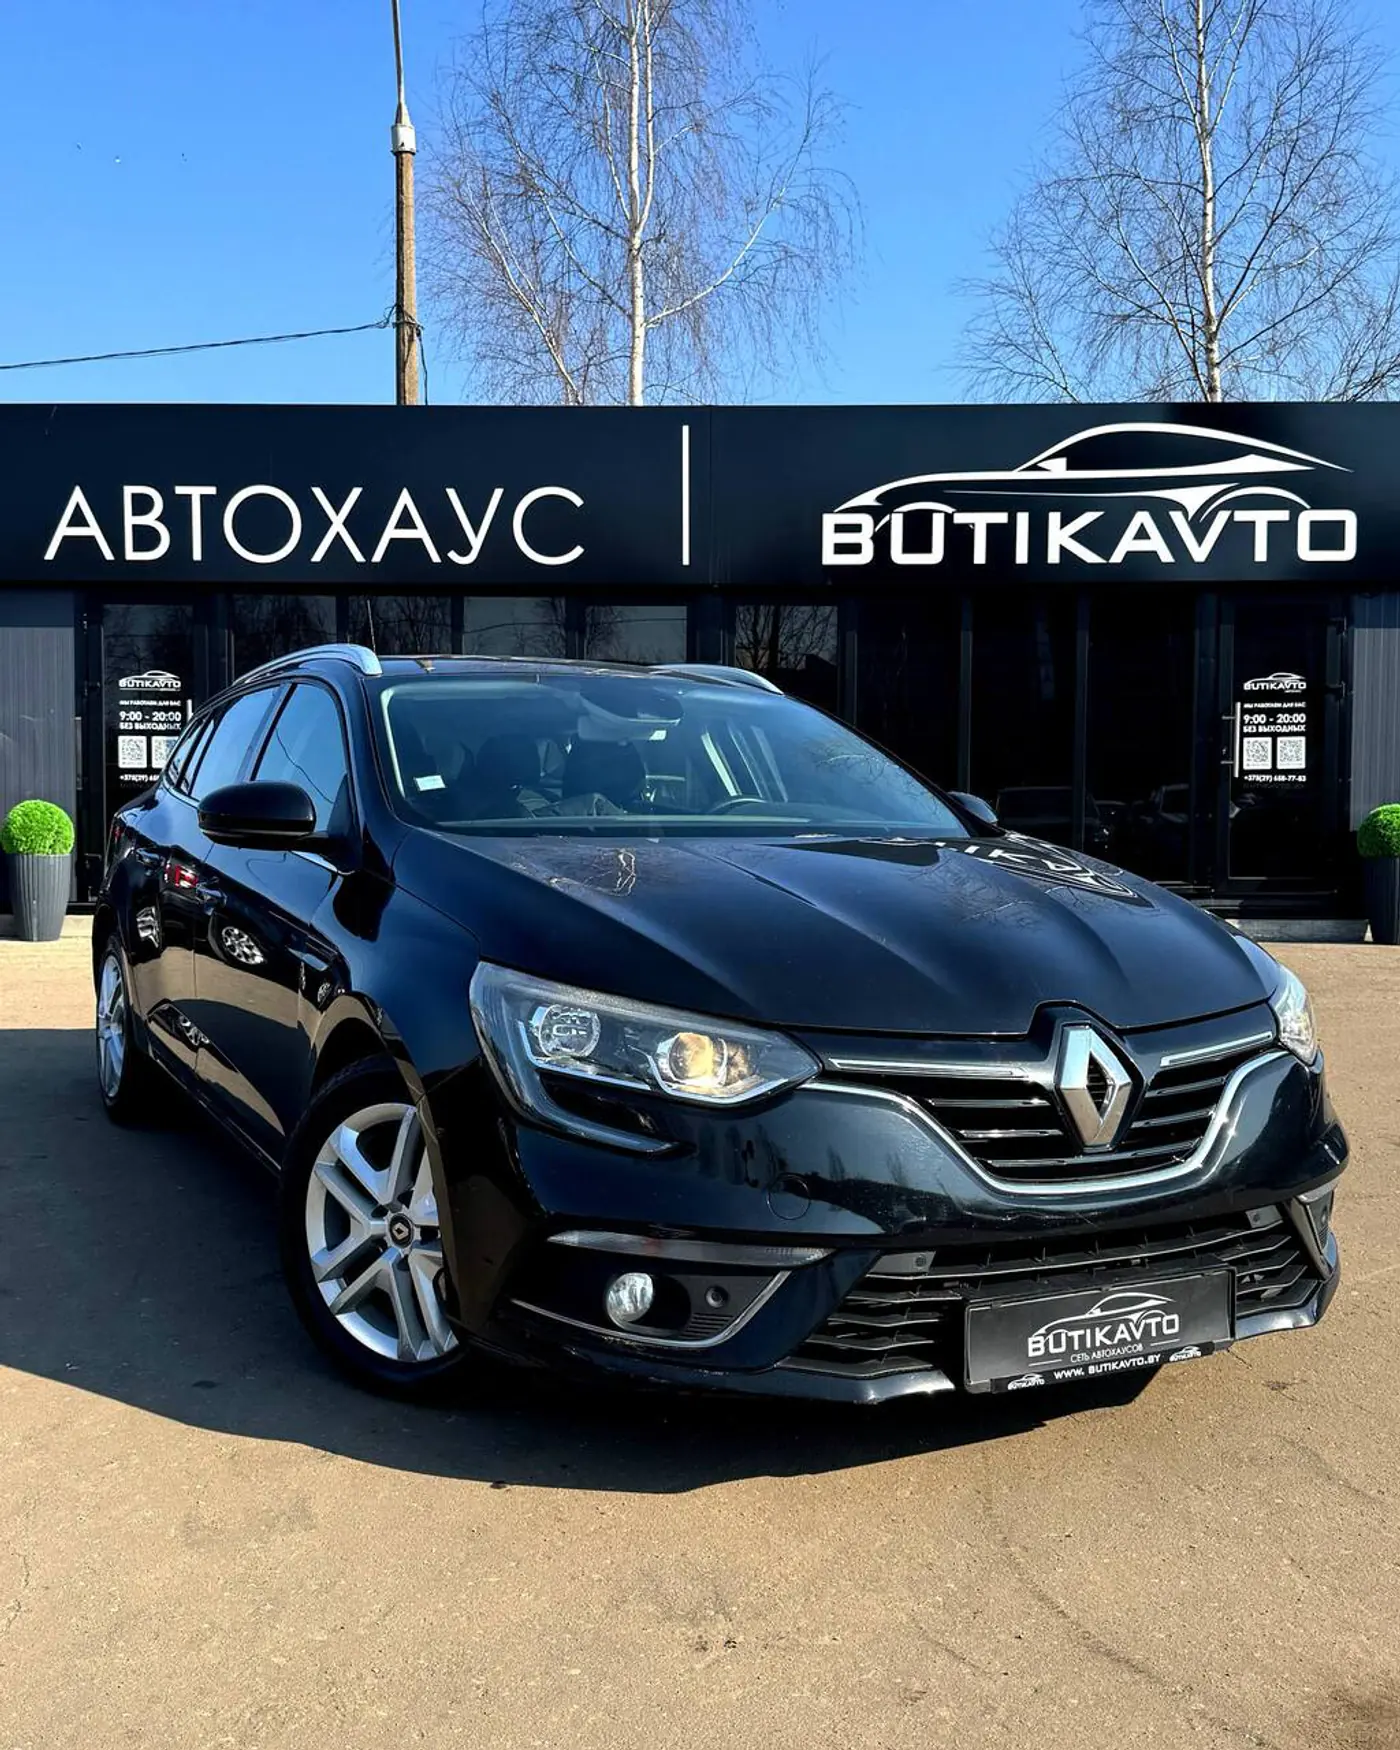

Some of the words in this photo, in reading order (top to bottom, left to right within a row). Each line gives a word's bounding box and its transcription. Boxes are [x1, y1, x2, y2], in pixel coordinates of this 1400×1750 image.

[43, 484, 586, 566] АВТОХАУС
[821, 508, 1358, 566] BUTIKAVTO
[118, 680, 181, 688] BUTIKAVTO
[1243, 682, 1307, 690] BUTIKAVTO
[119, 711, 143, 721] 9:00
[151, 711, 182, 722] 20:00
[1243, 714, 1266, 724] 9:00
[1276, 713, 1306, 724] 20:00
[119, 722, 133, 730] БЕЗ
[134, 722, 181, 730] ВЫХОДНЫХ
[1243, 725, 1257, 733] БЕЗ
[1258, 724, 1306, 733] ВЫХОДНЫХ
[1027, 1313, 1180, 1358] BUTIKAVTO
[1070, 1351, 1091, 1363] СЕТЬ
[1091, 1343, 1144, 1360] АВТОХАУСОВ
[1088, 1353, 1161, 1375] BUTIKAVTO.BY
